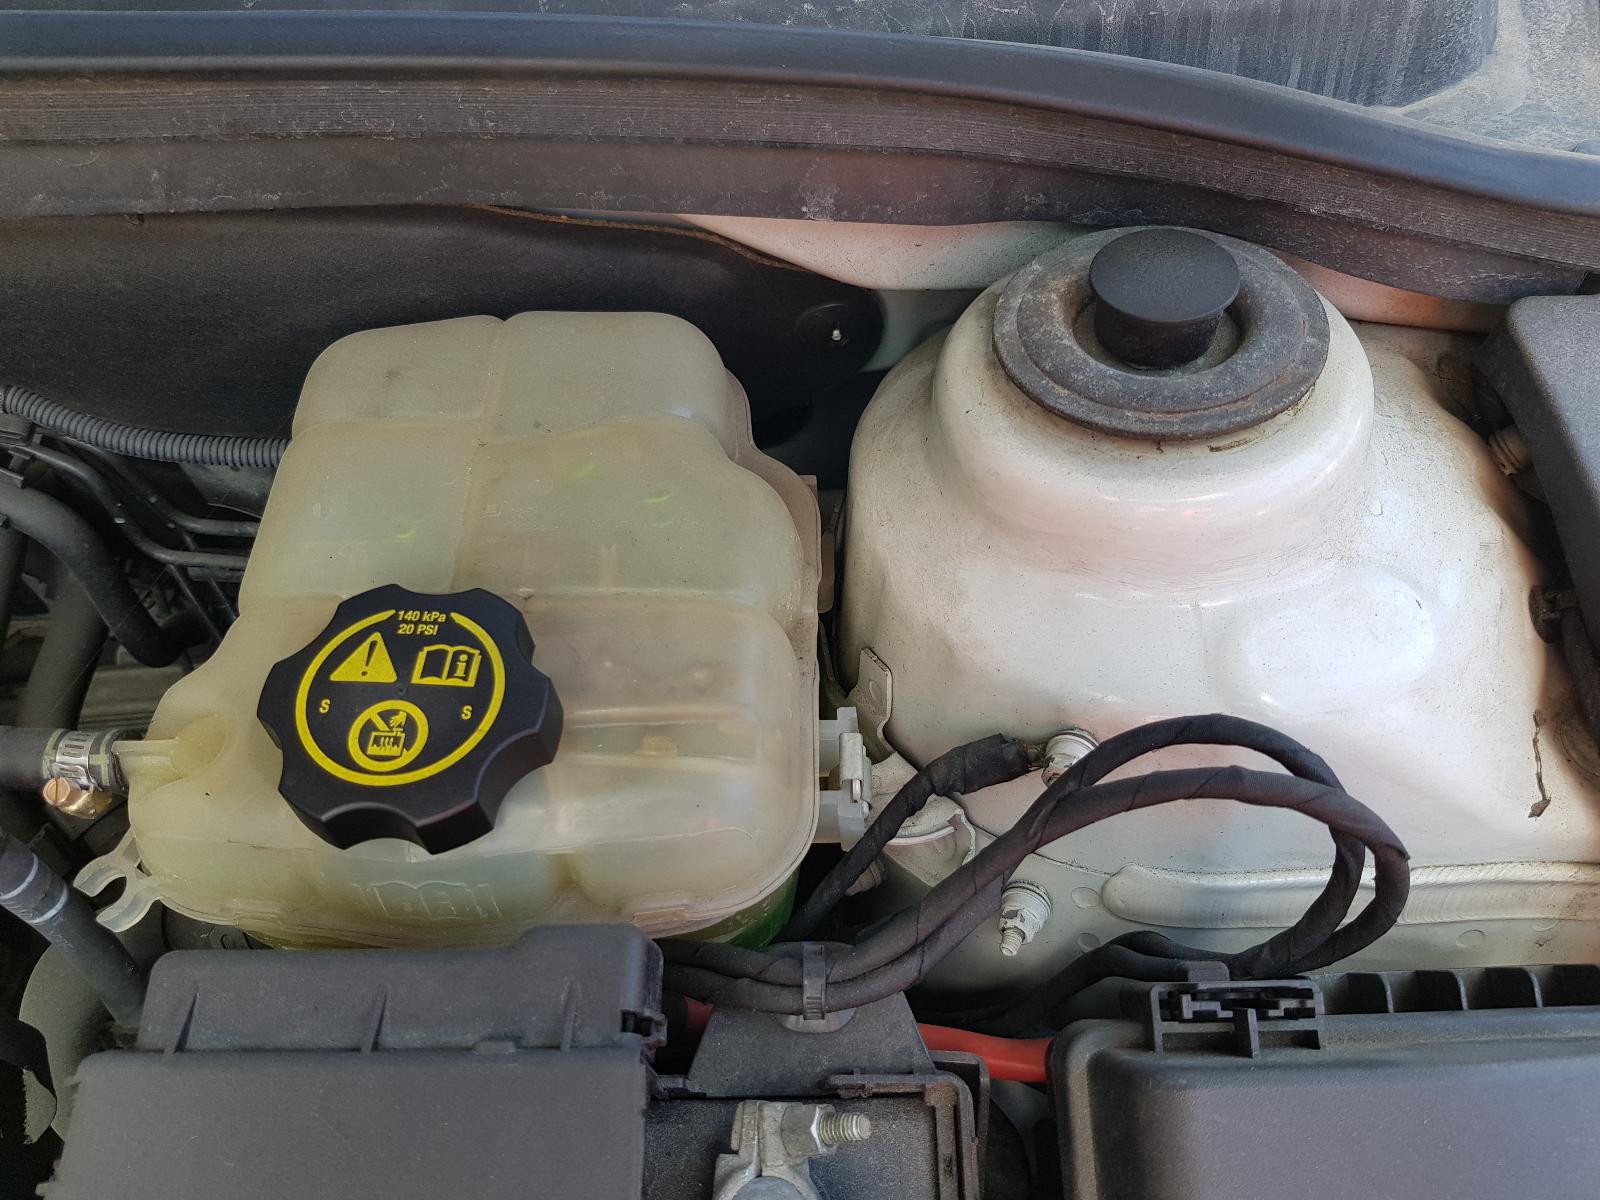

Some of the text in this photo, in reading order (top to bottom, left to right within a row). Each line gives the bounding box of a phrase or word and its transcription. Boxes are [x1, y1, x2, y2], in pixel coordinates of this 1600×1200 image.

[398, 610, 446, 623] 140 kPa
[398, 623, 438, 636] 20 PSI
[319, 698, 331, 714] S
[461, 705, 473, 720] S
